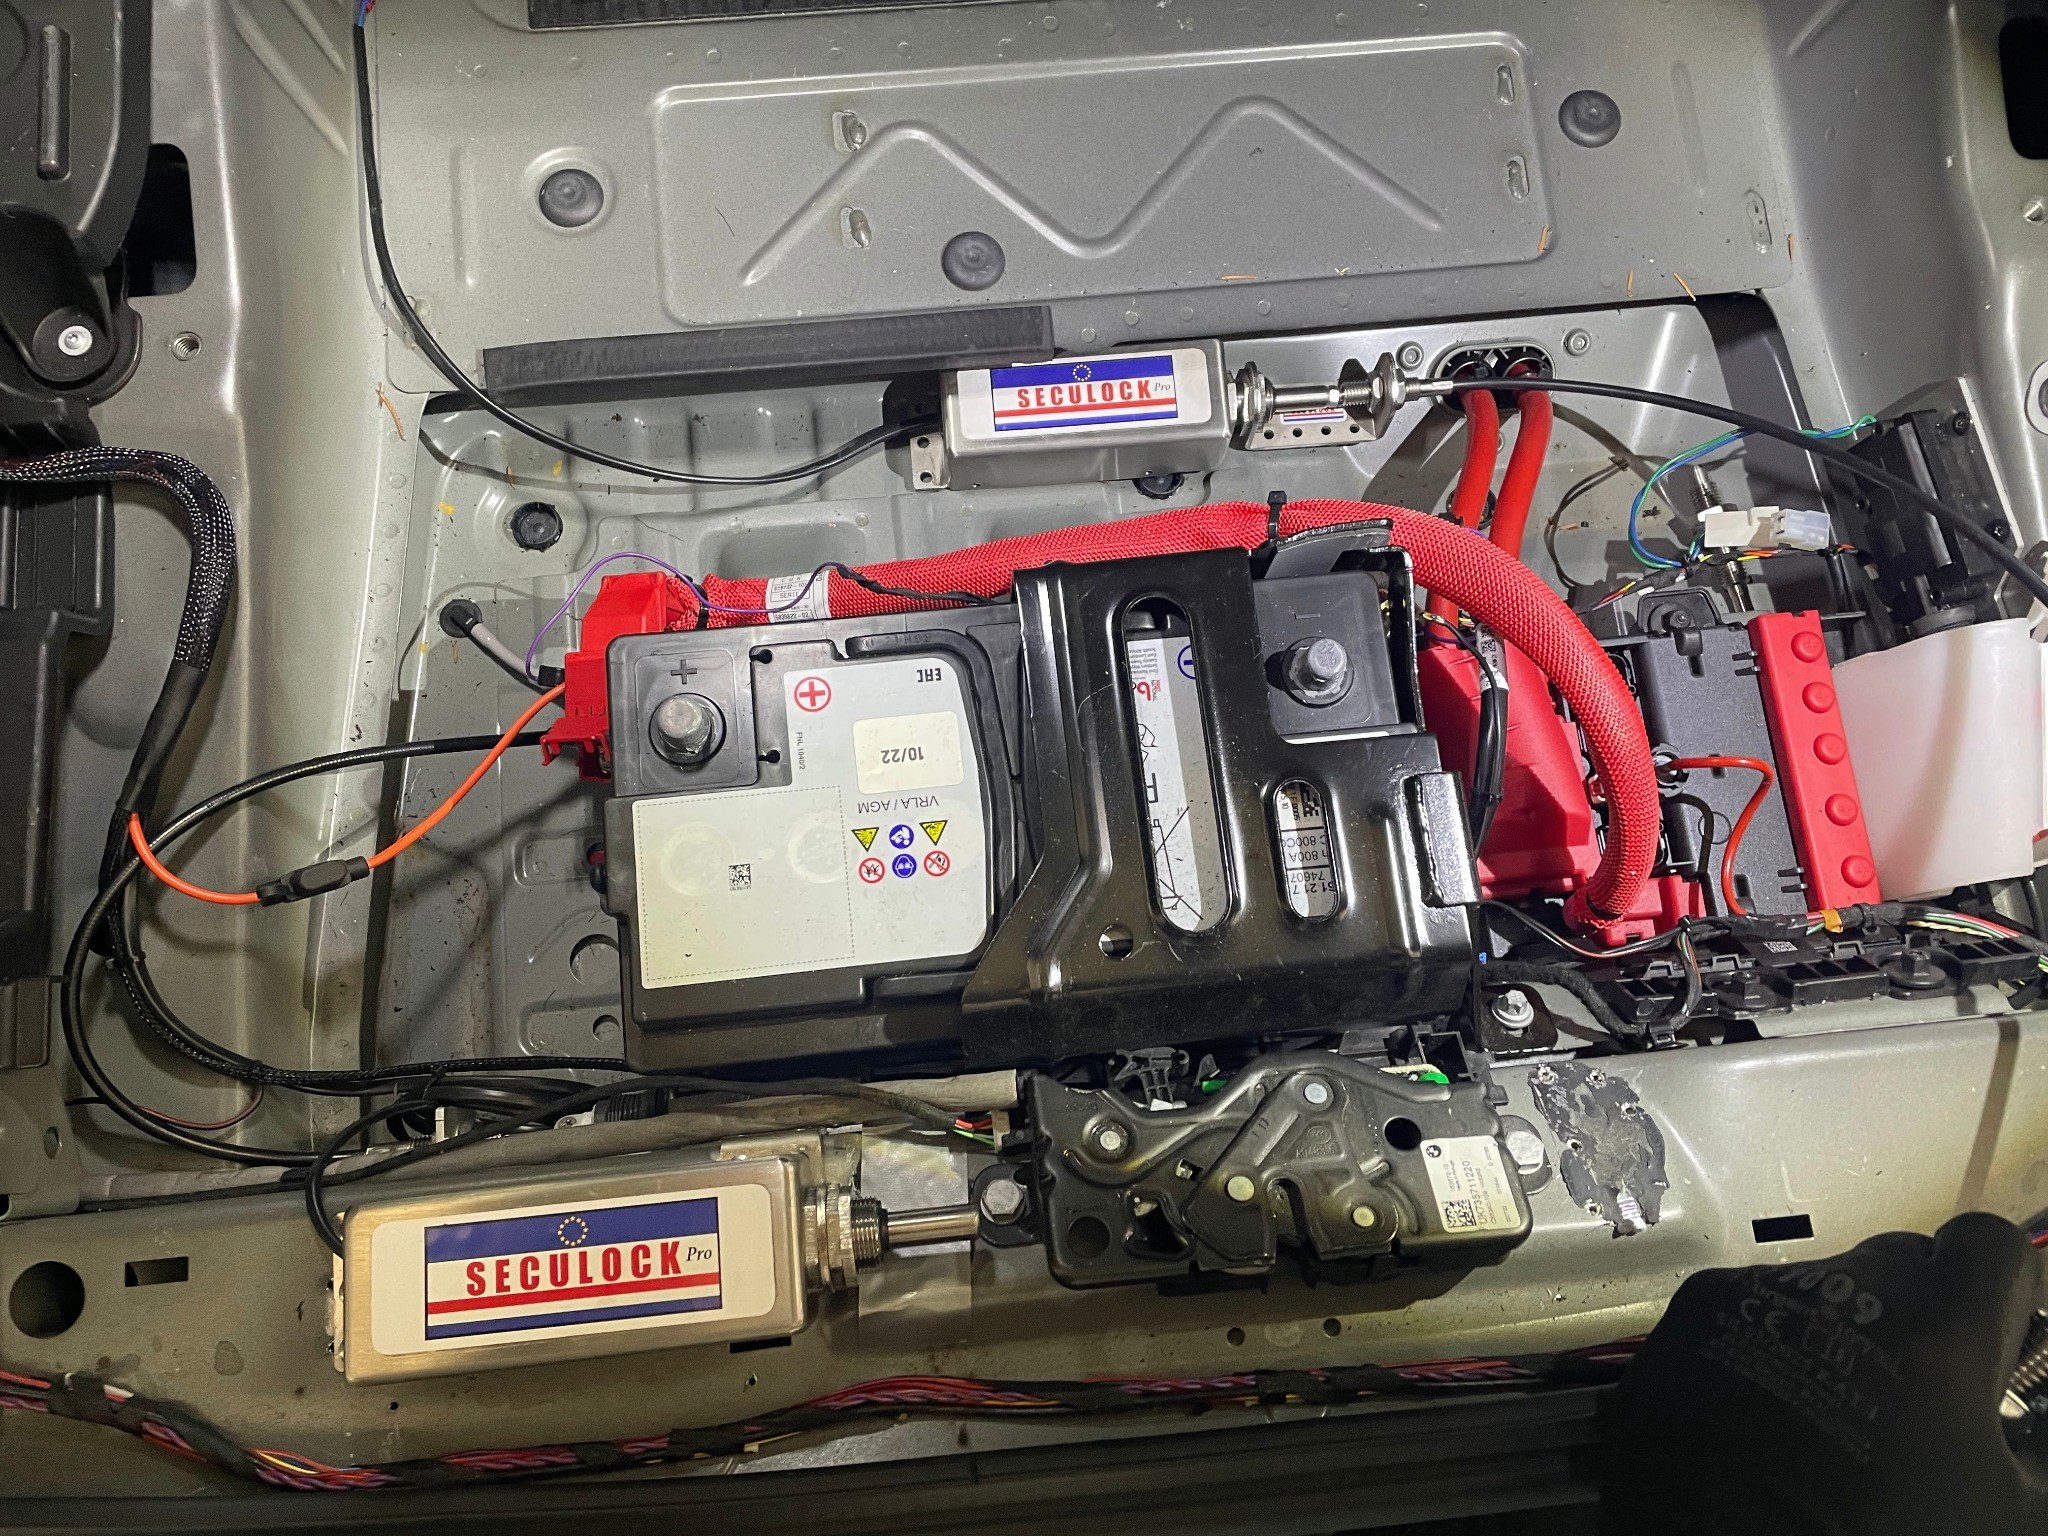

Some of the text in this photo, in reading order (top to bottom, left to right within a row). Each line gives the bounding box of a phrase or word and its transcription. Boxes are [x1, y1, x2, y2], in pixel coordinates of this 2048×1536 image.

[1017, 379, 1171, 408] SECULOCK Pro
[881, 746, 924, 764] 10/22
[858, 799, 891, 814] AGM
[901, 795, 939, 809] VRLA
[1289, 850, 1318, 862] 800A
[466, 1240, 713, 1296] SECULOCK Pro
